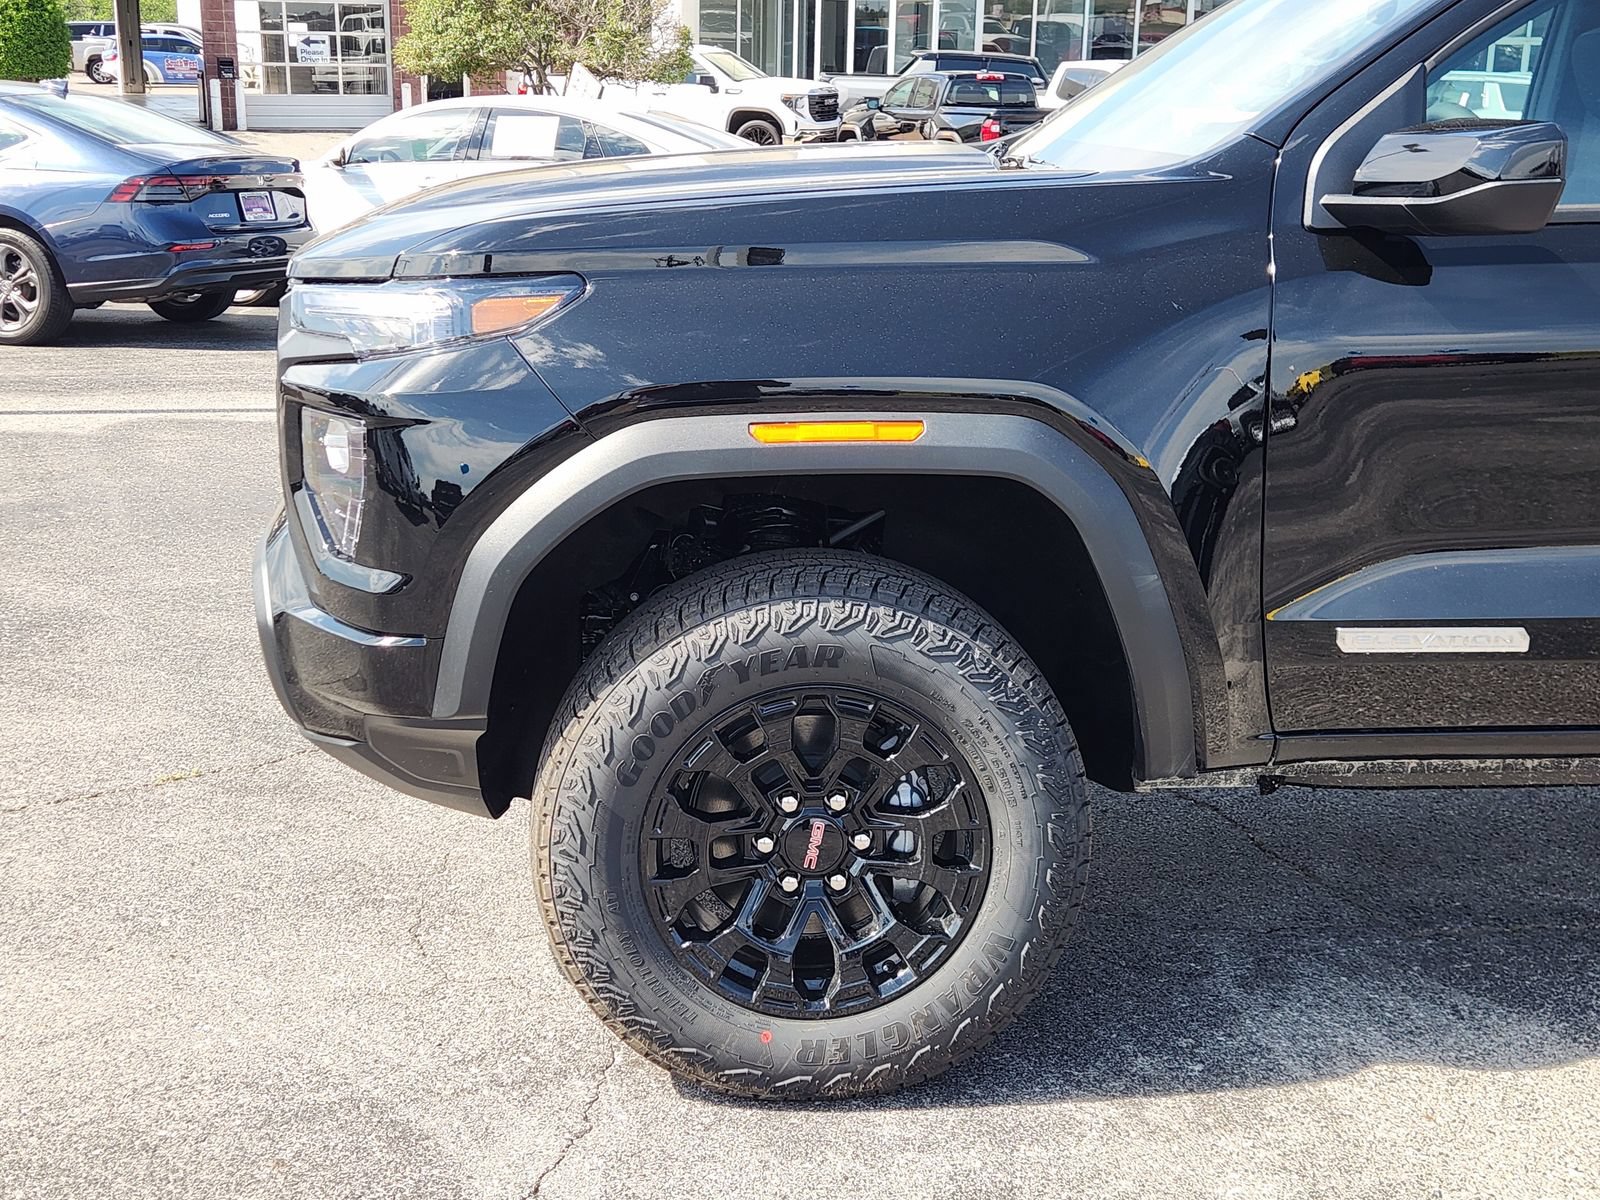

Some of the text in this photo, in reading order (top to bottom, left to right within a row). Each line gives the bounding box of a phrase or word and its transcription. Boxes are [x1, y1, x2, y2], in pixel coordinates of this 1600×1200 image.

[300, 48, 325, 56] Please
[1352, 633, 1515, 647] ELEVATION
[803, 821, 825, 870] GMC
[616, 928, 699, 1025] TERRITORY
[792, 930, 1016, 1067] WRANGLER
